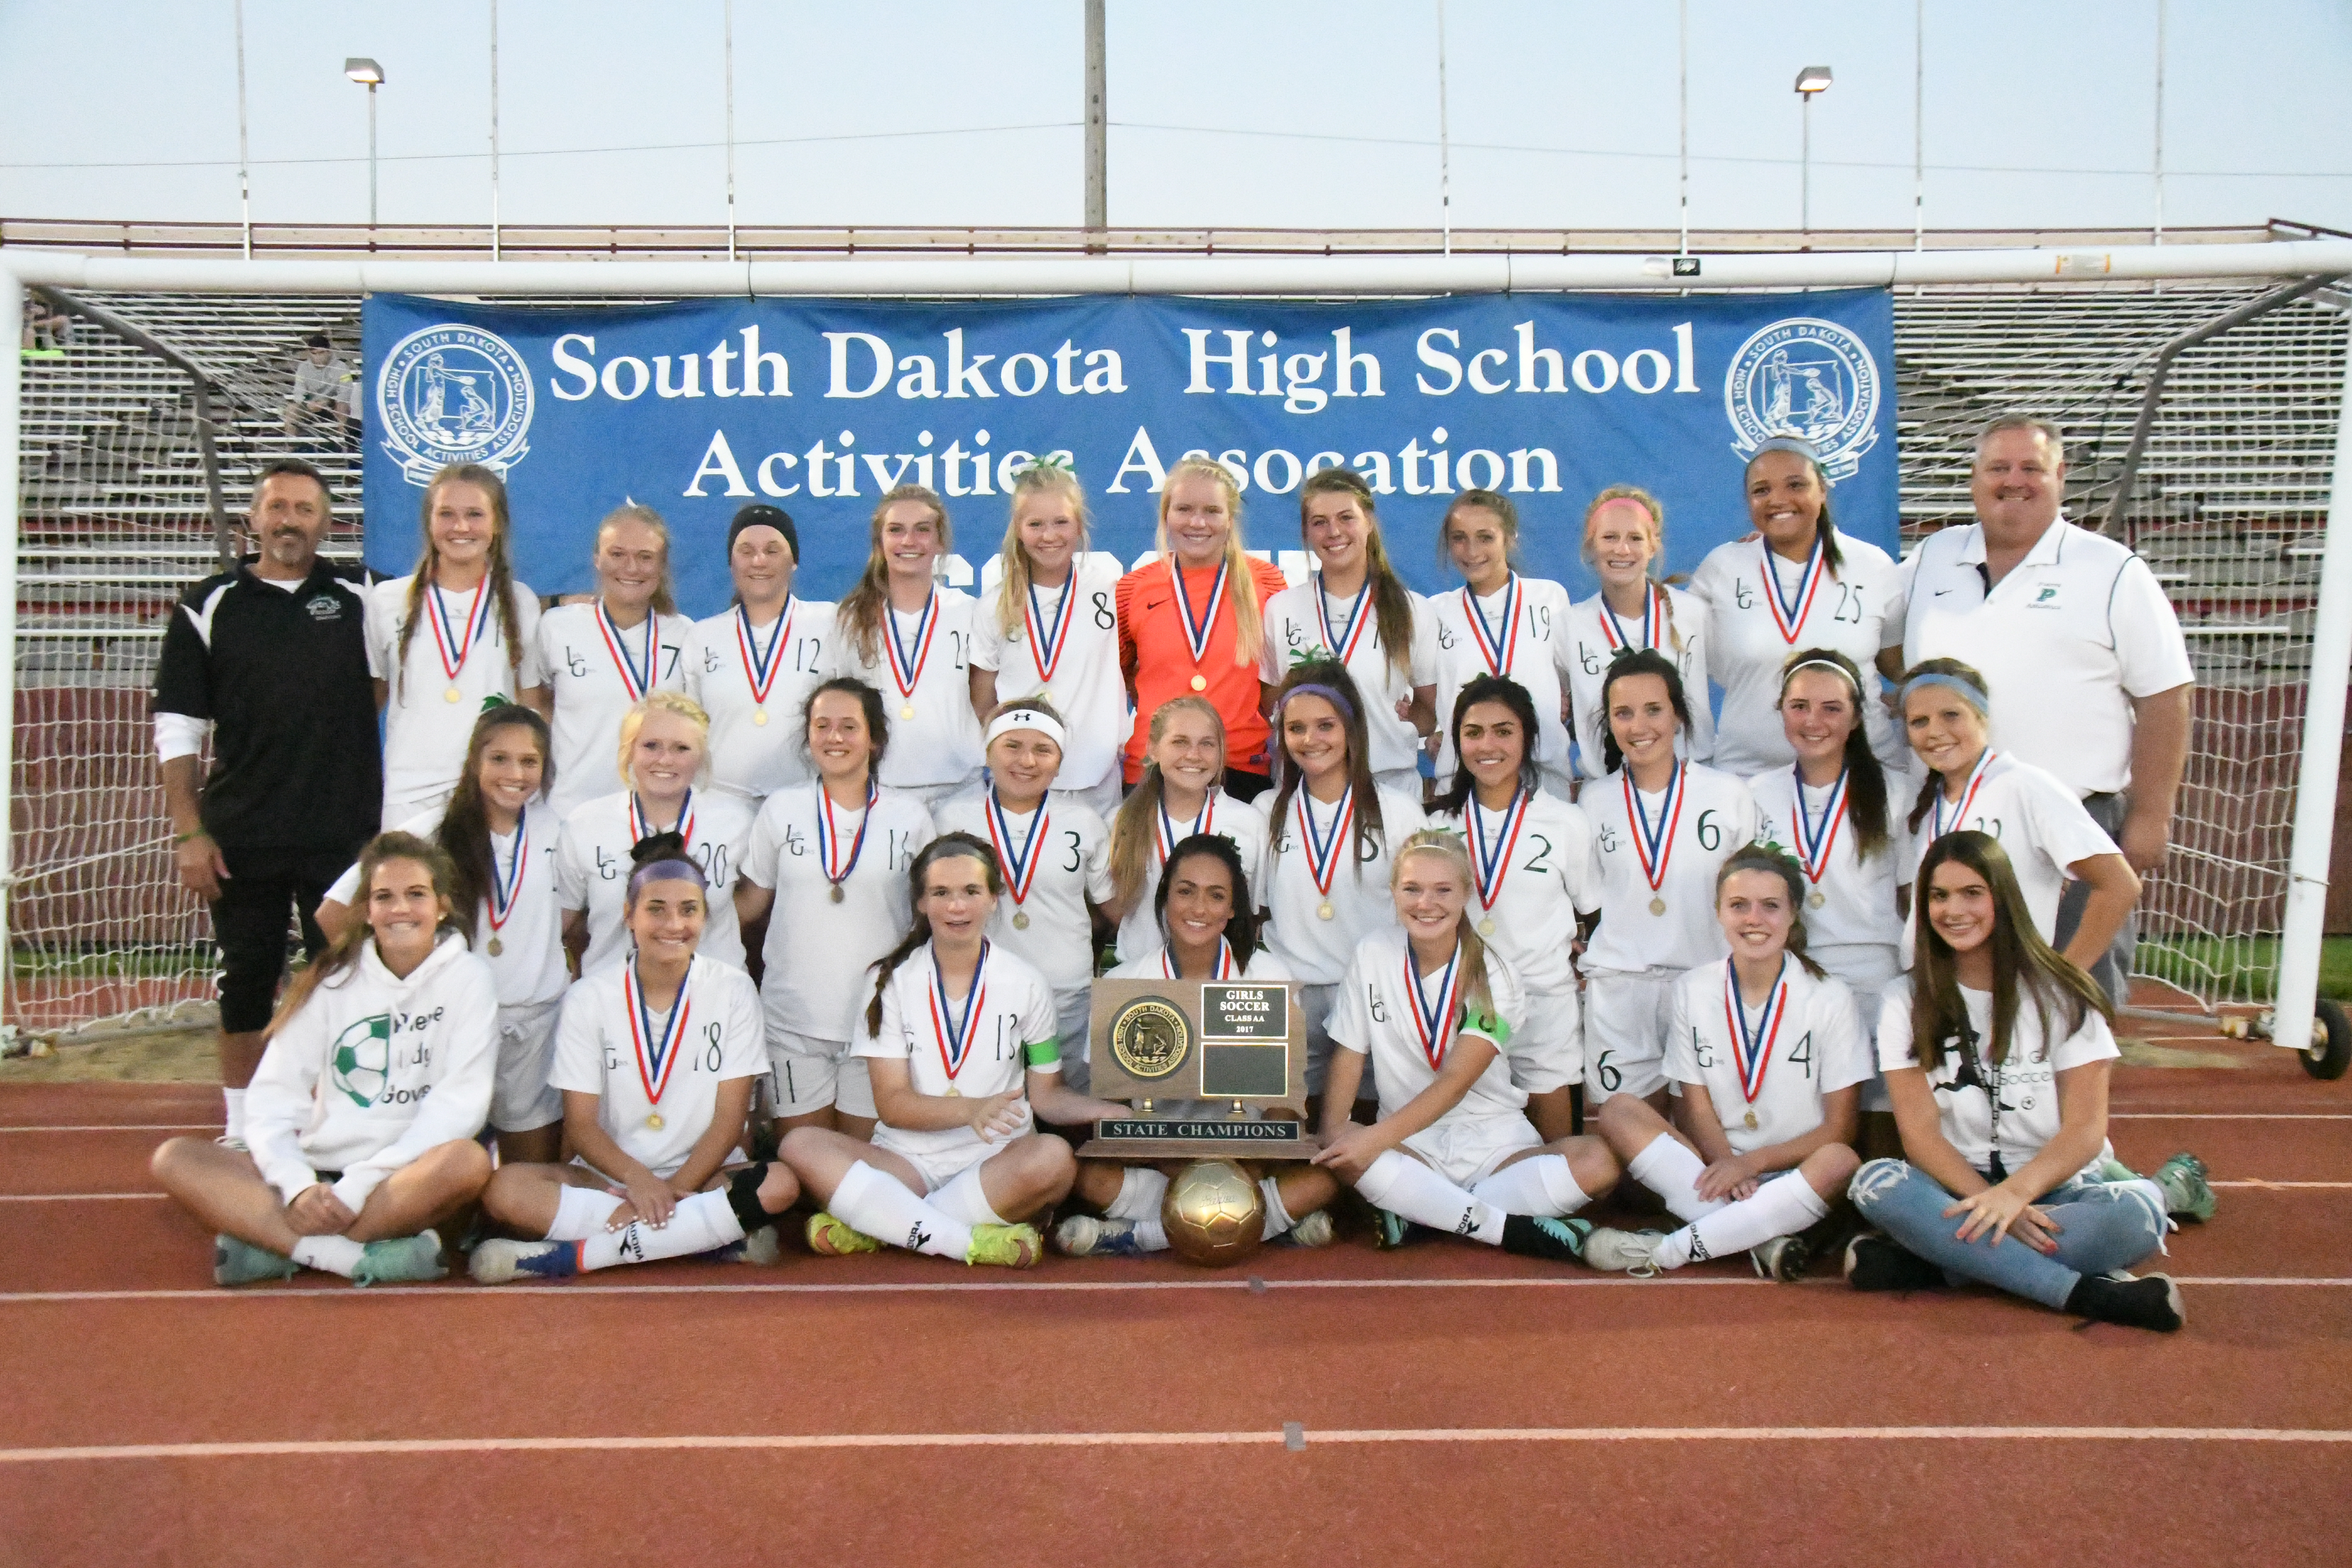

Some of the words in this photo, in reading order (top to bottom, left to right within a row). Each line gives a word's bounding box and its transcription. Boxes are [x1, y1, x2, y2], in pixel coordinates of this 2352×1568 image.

[404, 333, 449, 359] SOUTH
[457, 333, 509, 364] DAKOTA
[1750, 328, 1791, 359] SOUTH
[1799, 327, 1851, 353] DAKOTA
[551, 325, 793, 401] South
[822, 327, 1128, 400] Dakota
[1181, 326, 1385, 414] High
[1416, 321, 1701, 396] School
[423, 447, 489, 462] ACTIVITIES
[493, 373, 525, 451] ASSOCIATION
[1736, 404, 1766, 444] SCHOO
[1106, 426, 1563, 495] Asocation
[1092, 592, 1115, 629] 8
[1835, 581, 1864, 624] 25
[2037, 588, 2056, 602] P
[1529, 604, 1550, 641] 19
[662, 645, 680, 680] 7
[797, 638, 820, 674] 12
[1698, 809, 1720, 851] 6
[700, 843, 727, 888] 20
[1063, 831, 1081, 872] 3
[1523, 834, 1552, 873] 2
[1125, 1007, 1147, 1022] SOUTH
[1150, 1006, 1175, 1022] DAKOTA
[1220, 1002, 1270, 1011] SOCCER
[1226, 991, 1263, 1000] GIRLS
[1134, 1063, 1168, 1073] ACTIVITIES
[1597, 1050, 1622, 1092] 6
[1788, 1031, 1811, 1078] 4
[771, 1059, 796, 1103] 11
[1113, 1124, 1168, 1135] STATE
[1177, 1124, 1286, 1137] CHAMPIONS
